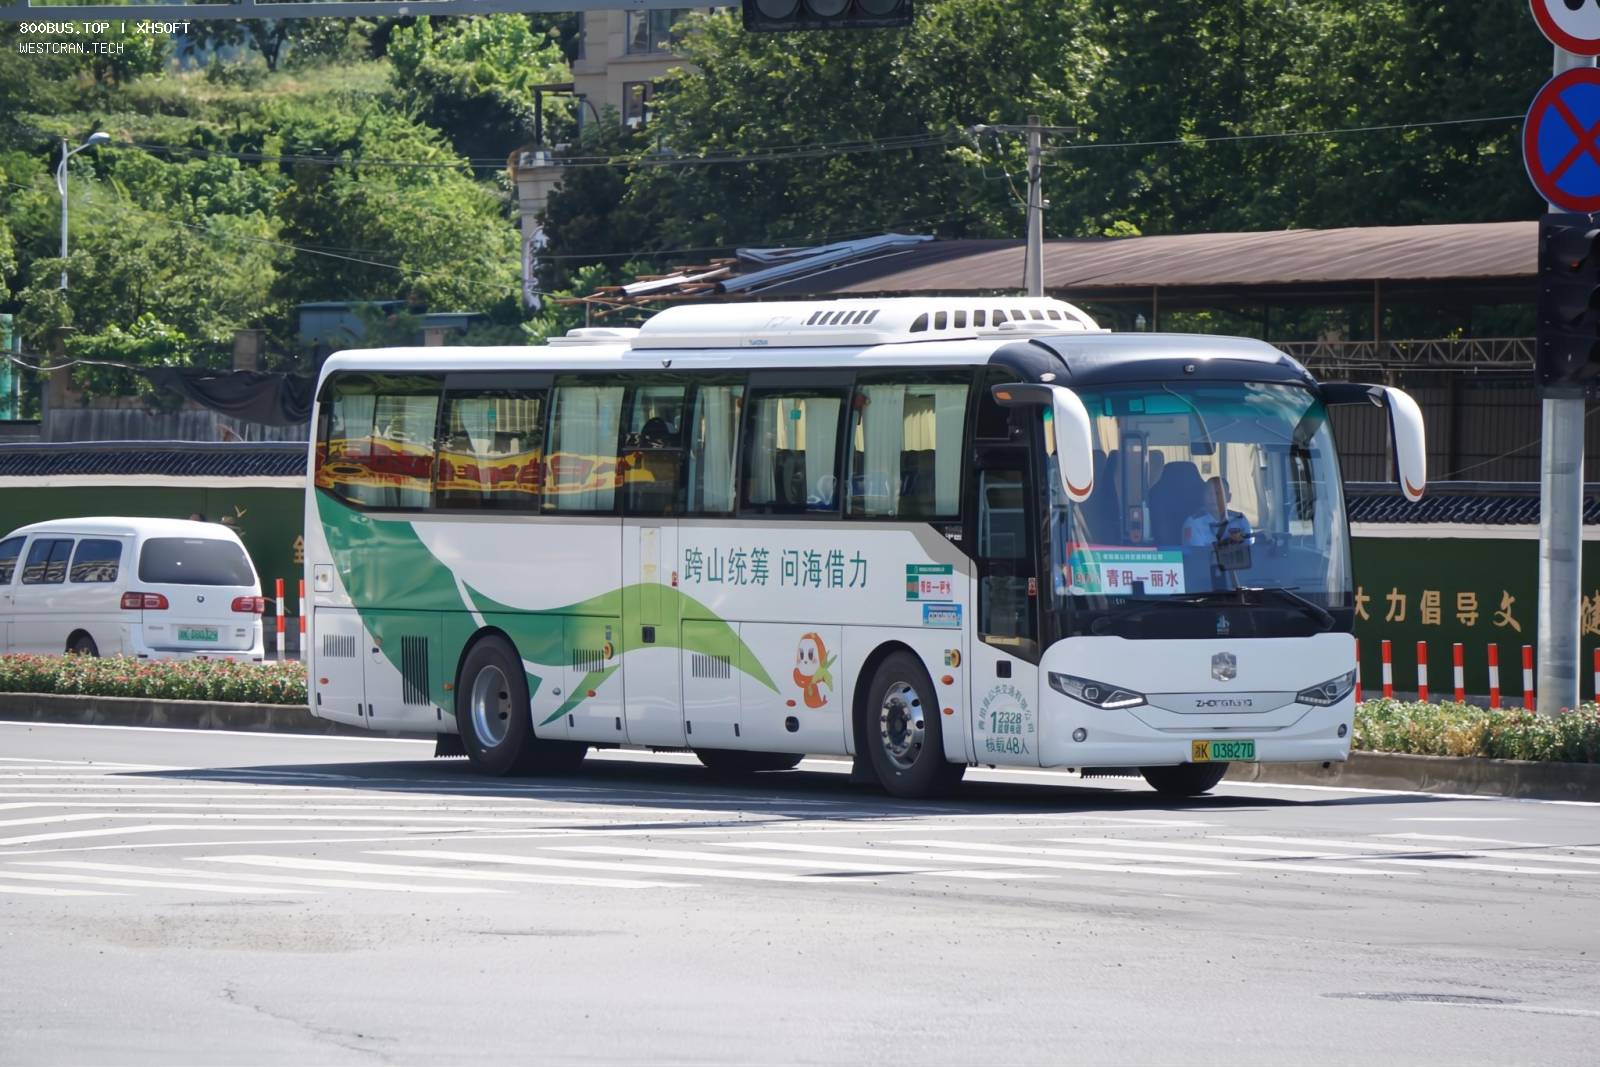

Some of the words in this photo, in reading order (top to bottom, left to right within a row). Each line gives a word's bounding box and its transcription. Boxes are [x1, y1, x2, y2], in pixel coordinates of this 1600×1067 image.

[684, 546, 769, 586] 跨山统筹
[780, 549, 867, 588] 问海借力
